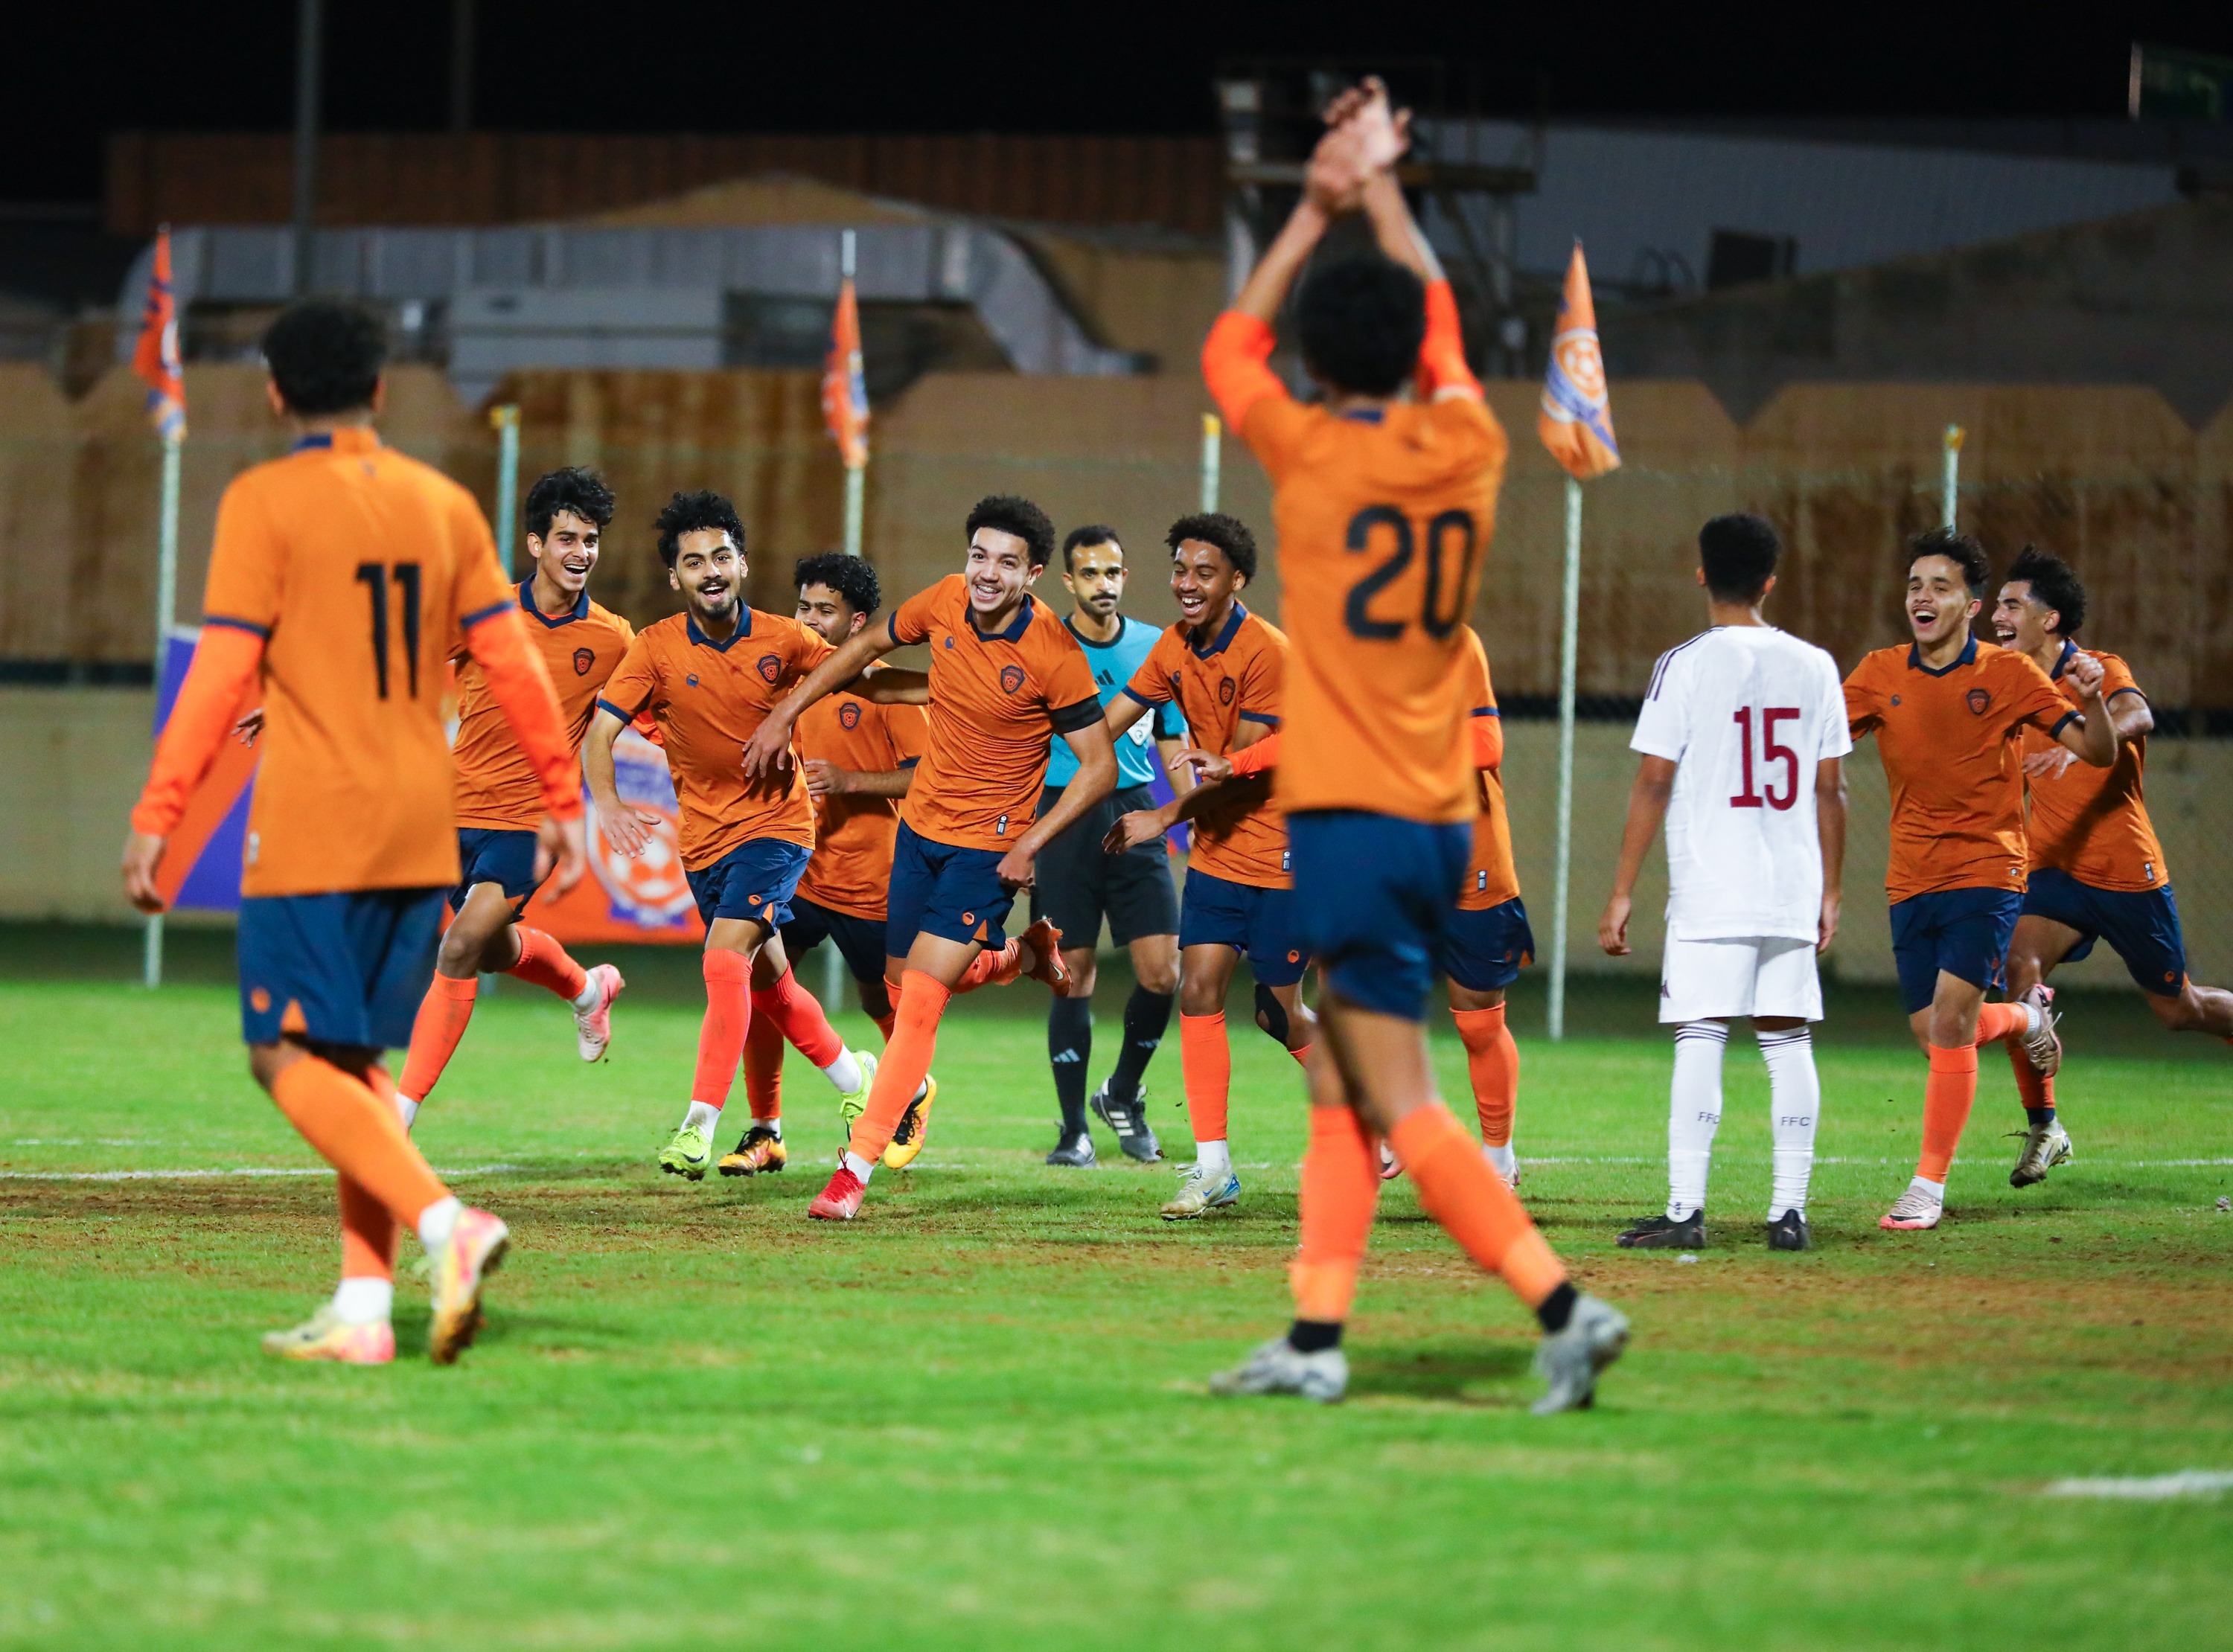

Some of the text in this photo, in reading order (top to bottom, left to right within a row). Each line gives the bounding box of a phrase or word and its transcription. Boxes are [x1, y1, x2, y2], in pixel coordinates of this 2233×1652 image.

[356, 563, 421, 699] 11
[1346, 505, 1475, 639] 20
[1730, 706, 1800, 810] 15
[1781, 1116, 1810, 1127] FFC
